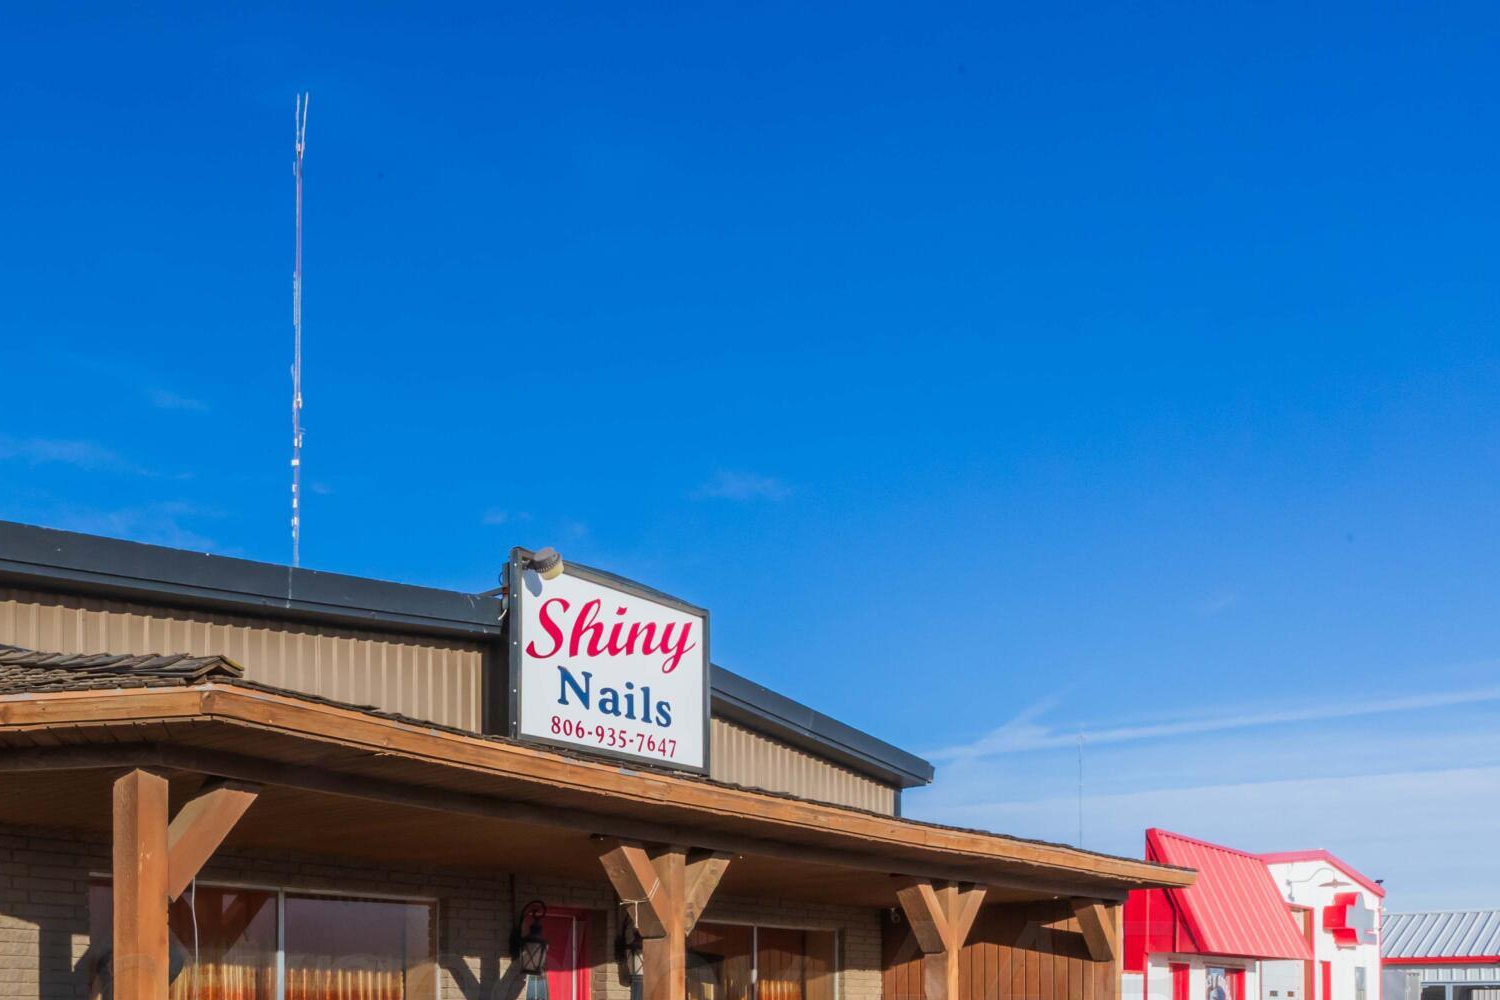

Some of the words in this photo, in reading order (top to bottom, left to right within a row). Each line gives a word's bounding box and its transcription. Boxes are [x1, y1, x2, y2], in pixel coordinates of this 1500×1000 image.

[526, 598, 696, 674] Shiny
[557, 665, 672, 728] Nails
[551, 716, 677, 758] 806-935-7647
